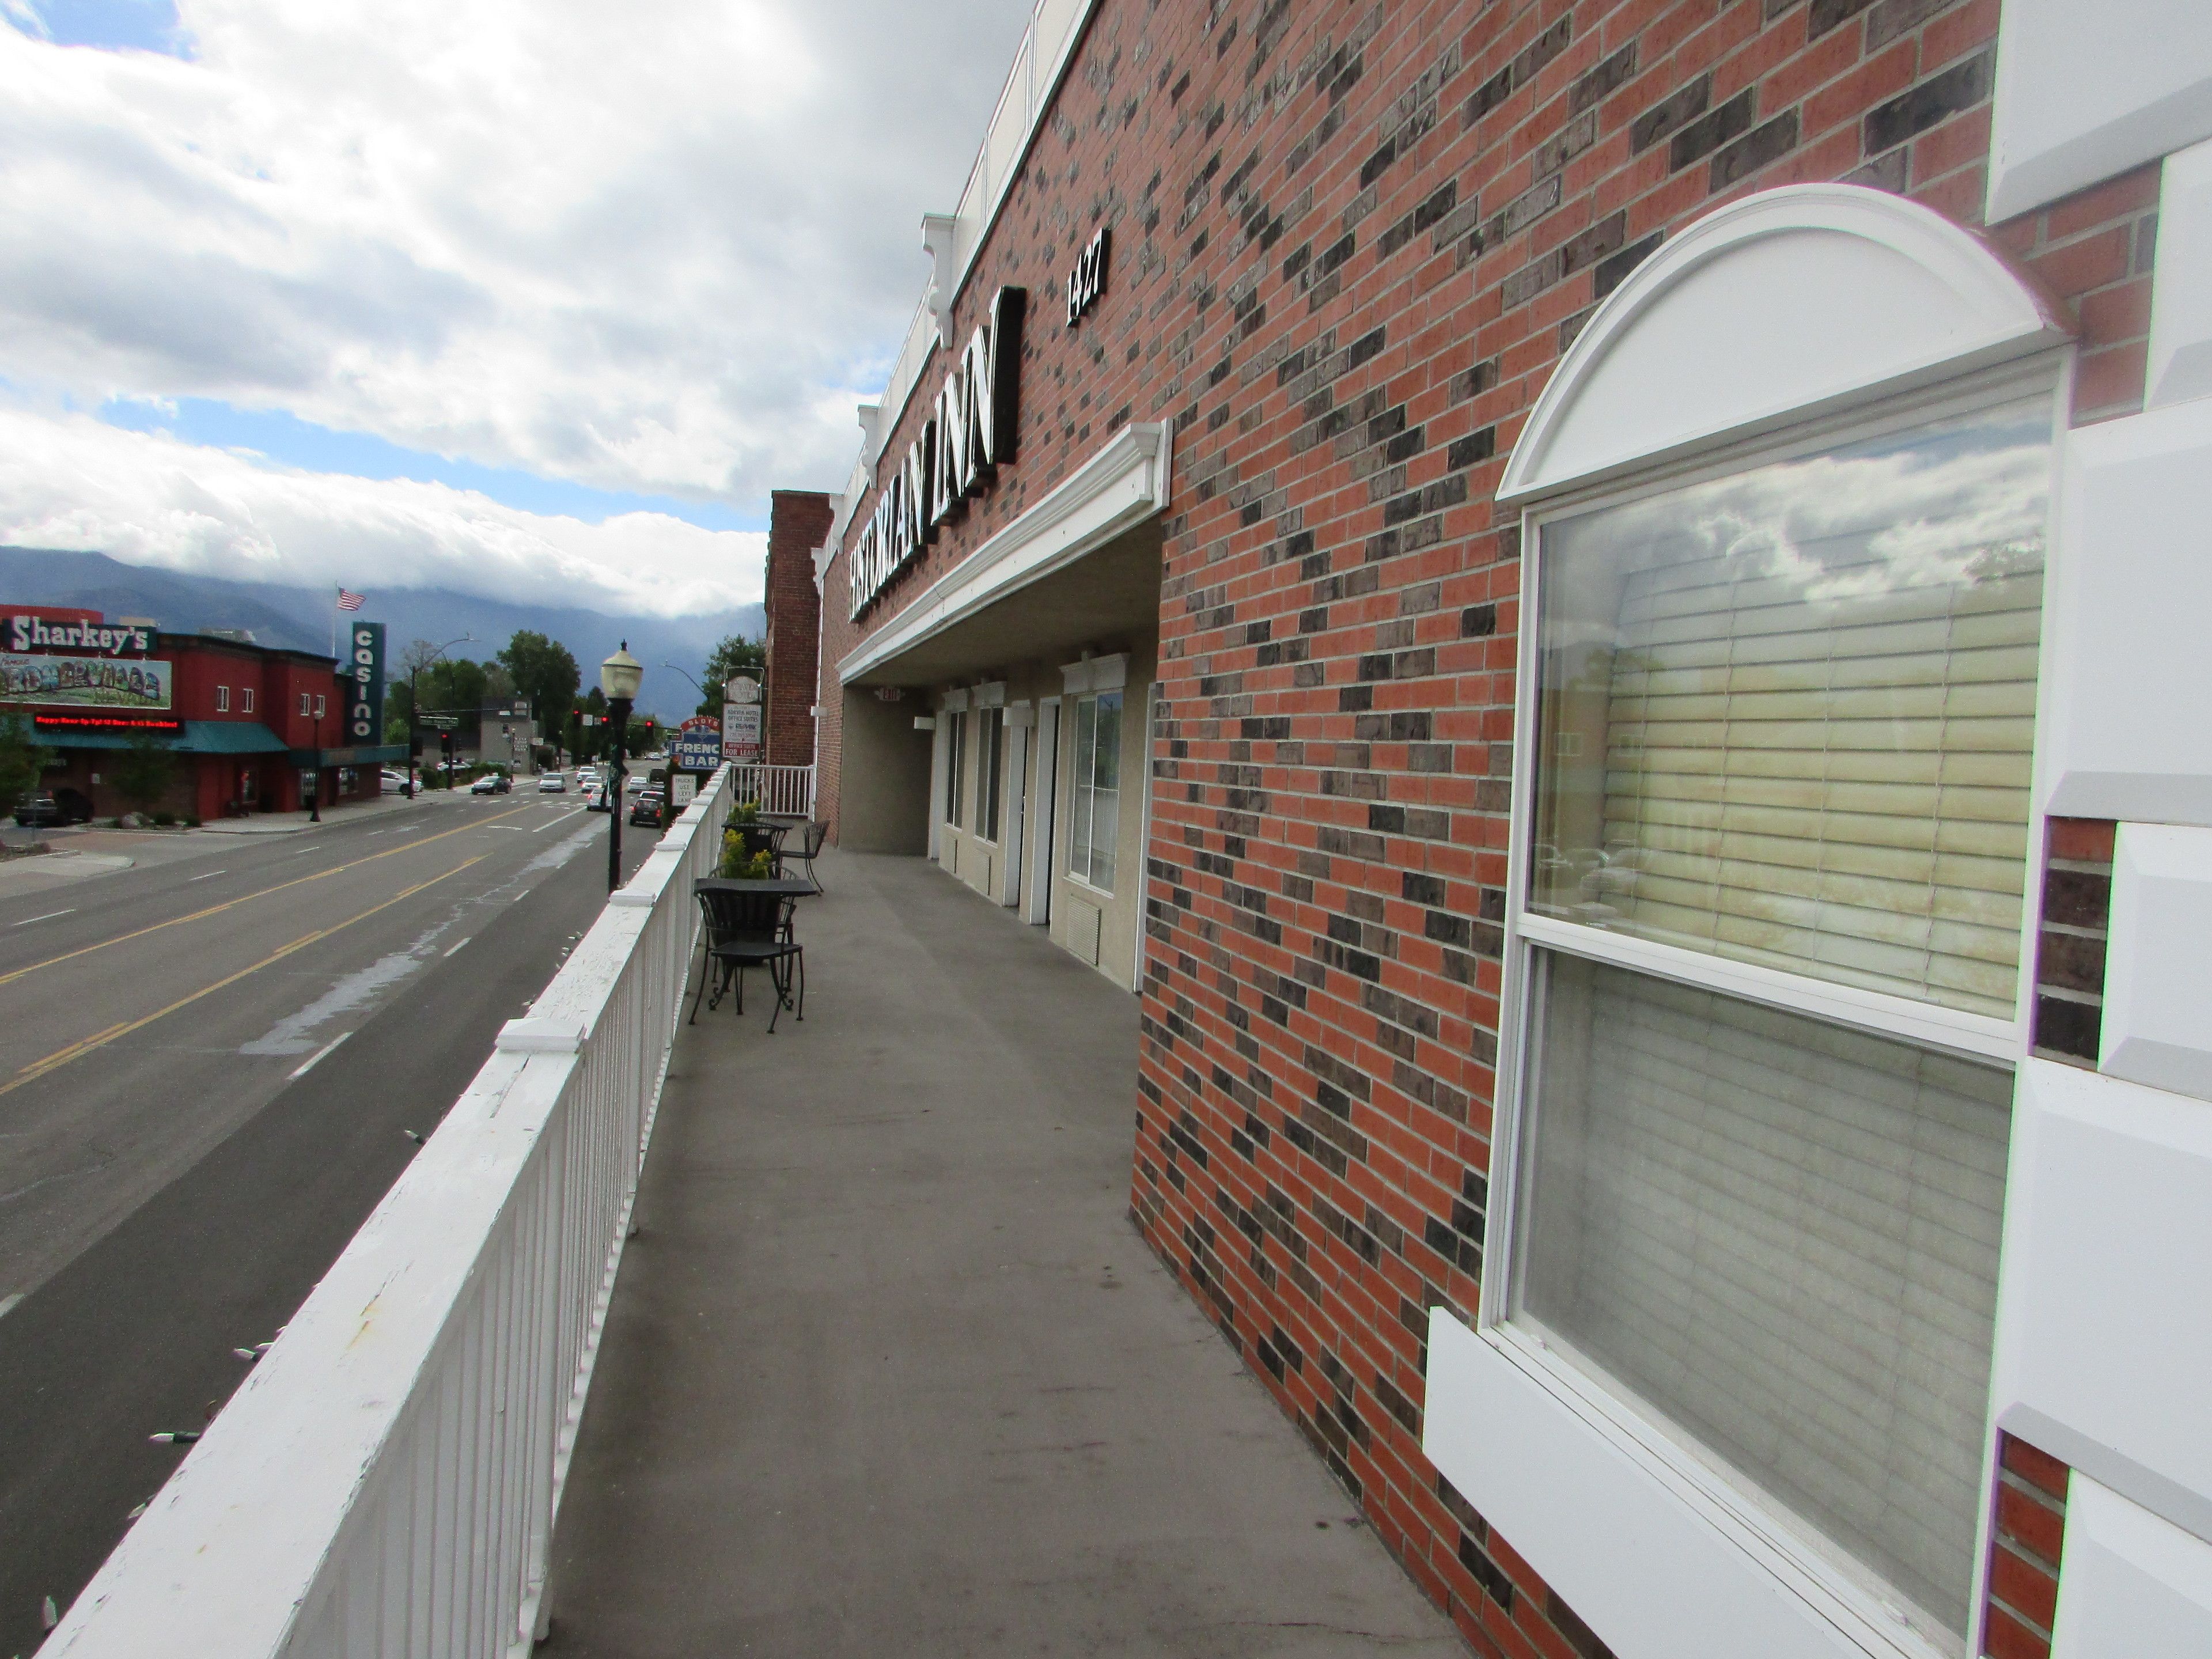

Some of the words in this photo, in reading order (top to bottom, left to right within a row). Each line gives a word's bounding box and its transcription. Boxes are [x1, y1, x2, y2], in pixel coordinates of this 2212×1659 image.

[1066, 228, 1103, 327] 1427
[849, 420, 930, 623] HISTORIAN
[931, 285, 1005, 525] INN
[12, 615, 149, 654] Sharkey's
[688, 718, 718, 726] SLOTS
[675, 743, 719, 753] FRENC
[685, 755, 718, 766] BAR
